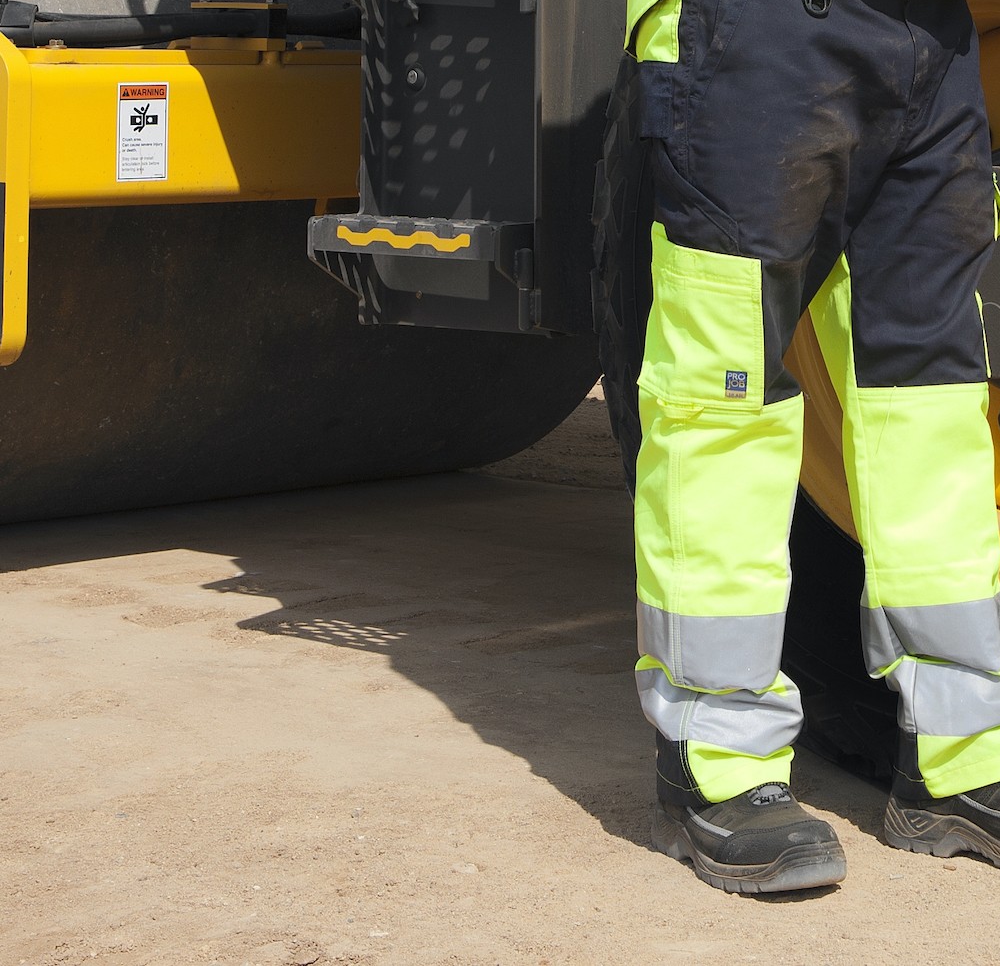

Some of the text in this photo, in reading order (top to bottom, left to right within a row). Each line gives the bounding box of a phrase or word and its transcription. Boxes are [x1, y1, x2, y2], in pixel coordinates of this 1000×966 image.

[130, 88, 165, 96] WARNING
[727, 372, 746, 381] PRO
[727, 380, 746, 389] JOB
